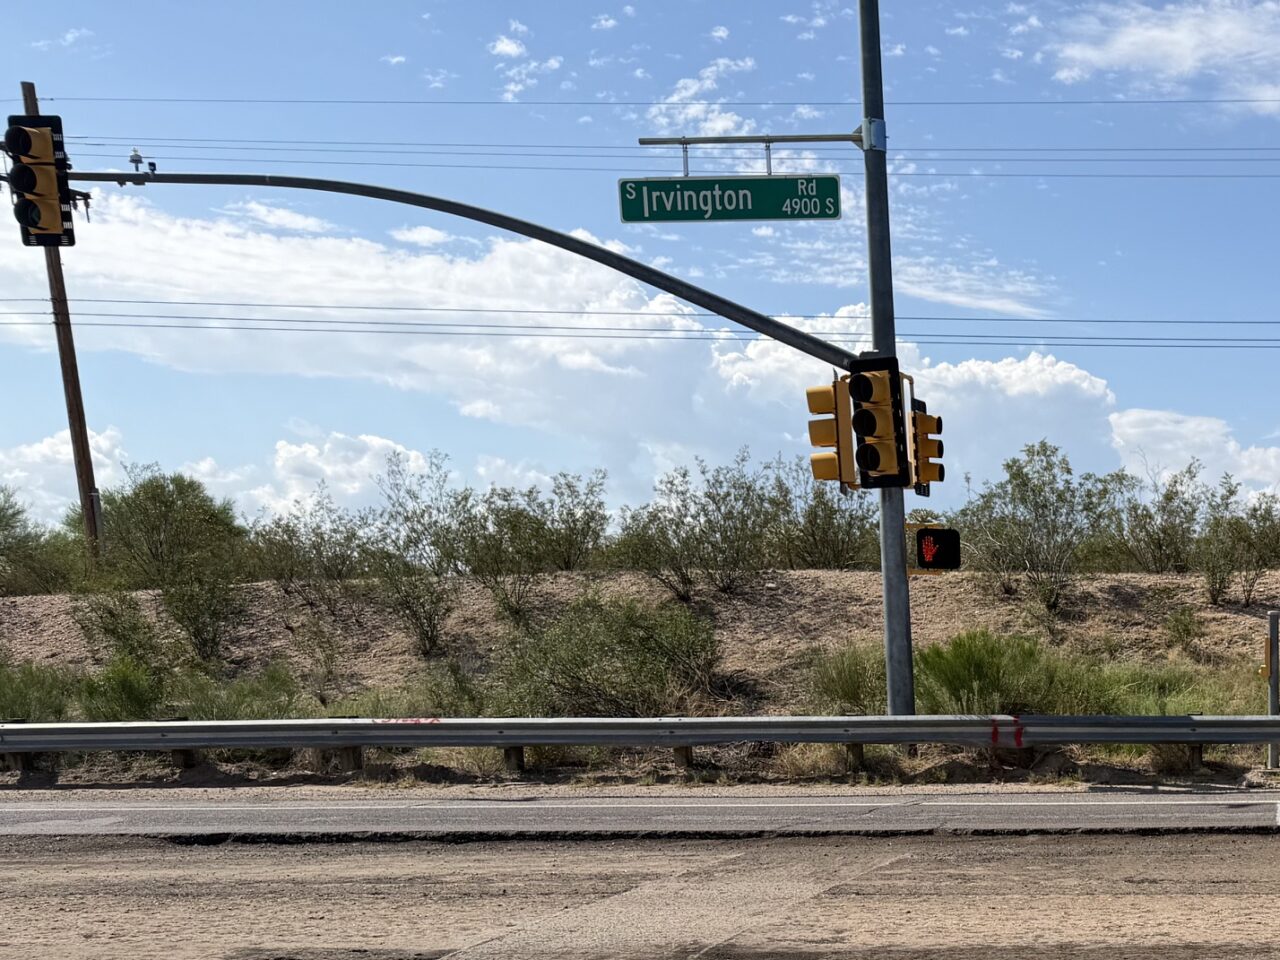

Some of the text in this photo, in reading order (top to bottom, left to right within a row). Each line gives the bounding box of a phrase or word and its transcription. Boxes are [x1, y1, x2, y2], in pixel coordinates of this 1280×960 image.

[797, 180, 817, 196] Rd
[625, 183, 752, 219] S Irvington
[782, 197, 835, 216] 4900 S
